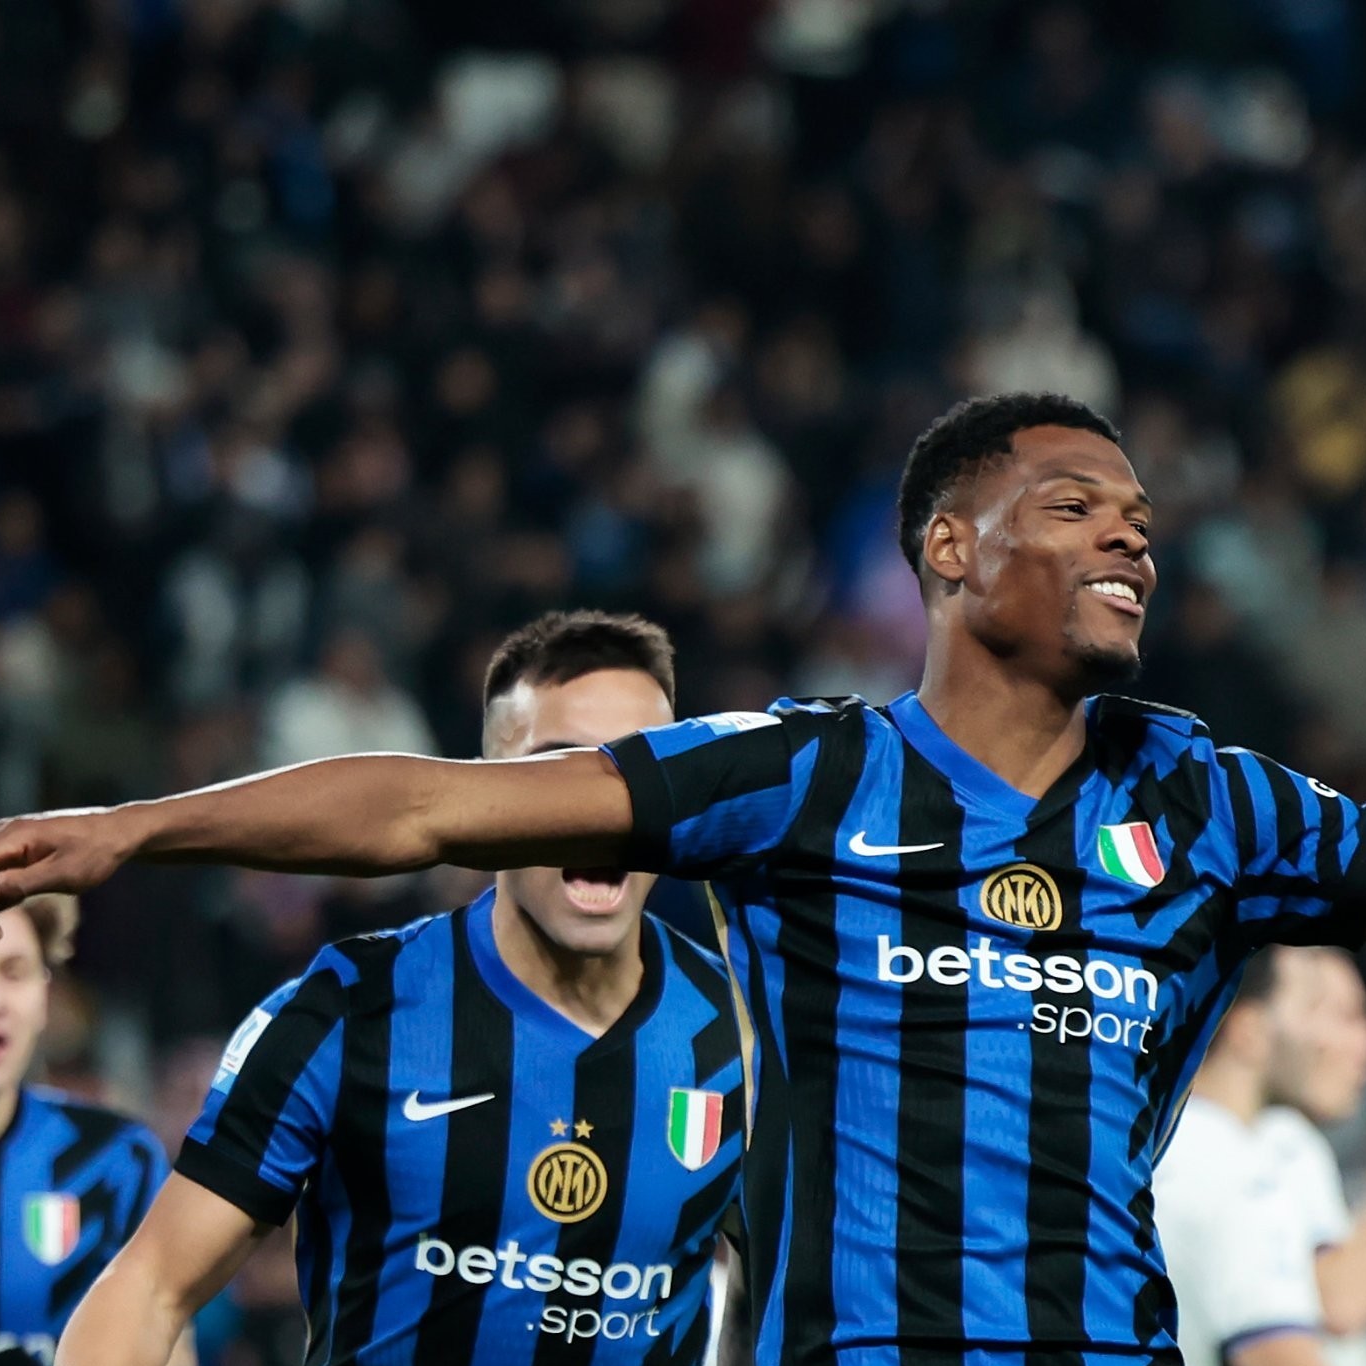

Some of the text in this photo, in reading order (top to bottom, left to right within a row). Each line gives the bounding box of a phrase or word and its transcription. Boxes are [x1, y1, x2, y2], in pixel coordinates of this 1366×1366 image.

[877, 935, 1158, 1009] betsson
[1017, 1002, 1153, 1055] .sport
[416, 1233, 673, 1301] betsson
[526, 1304, 661, 1344] .sport
